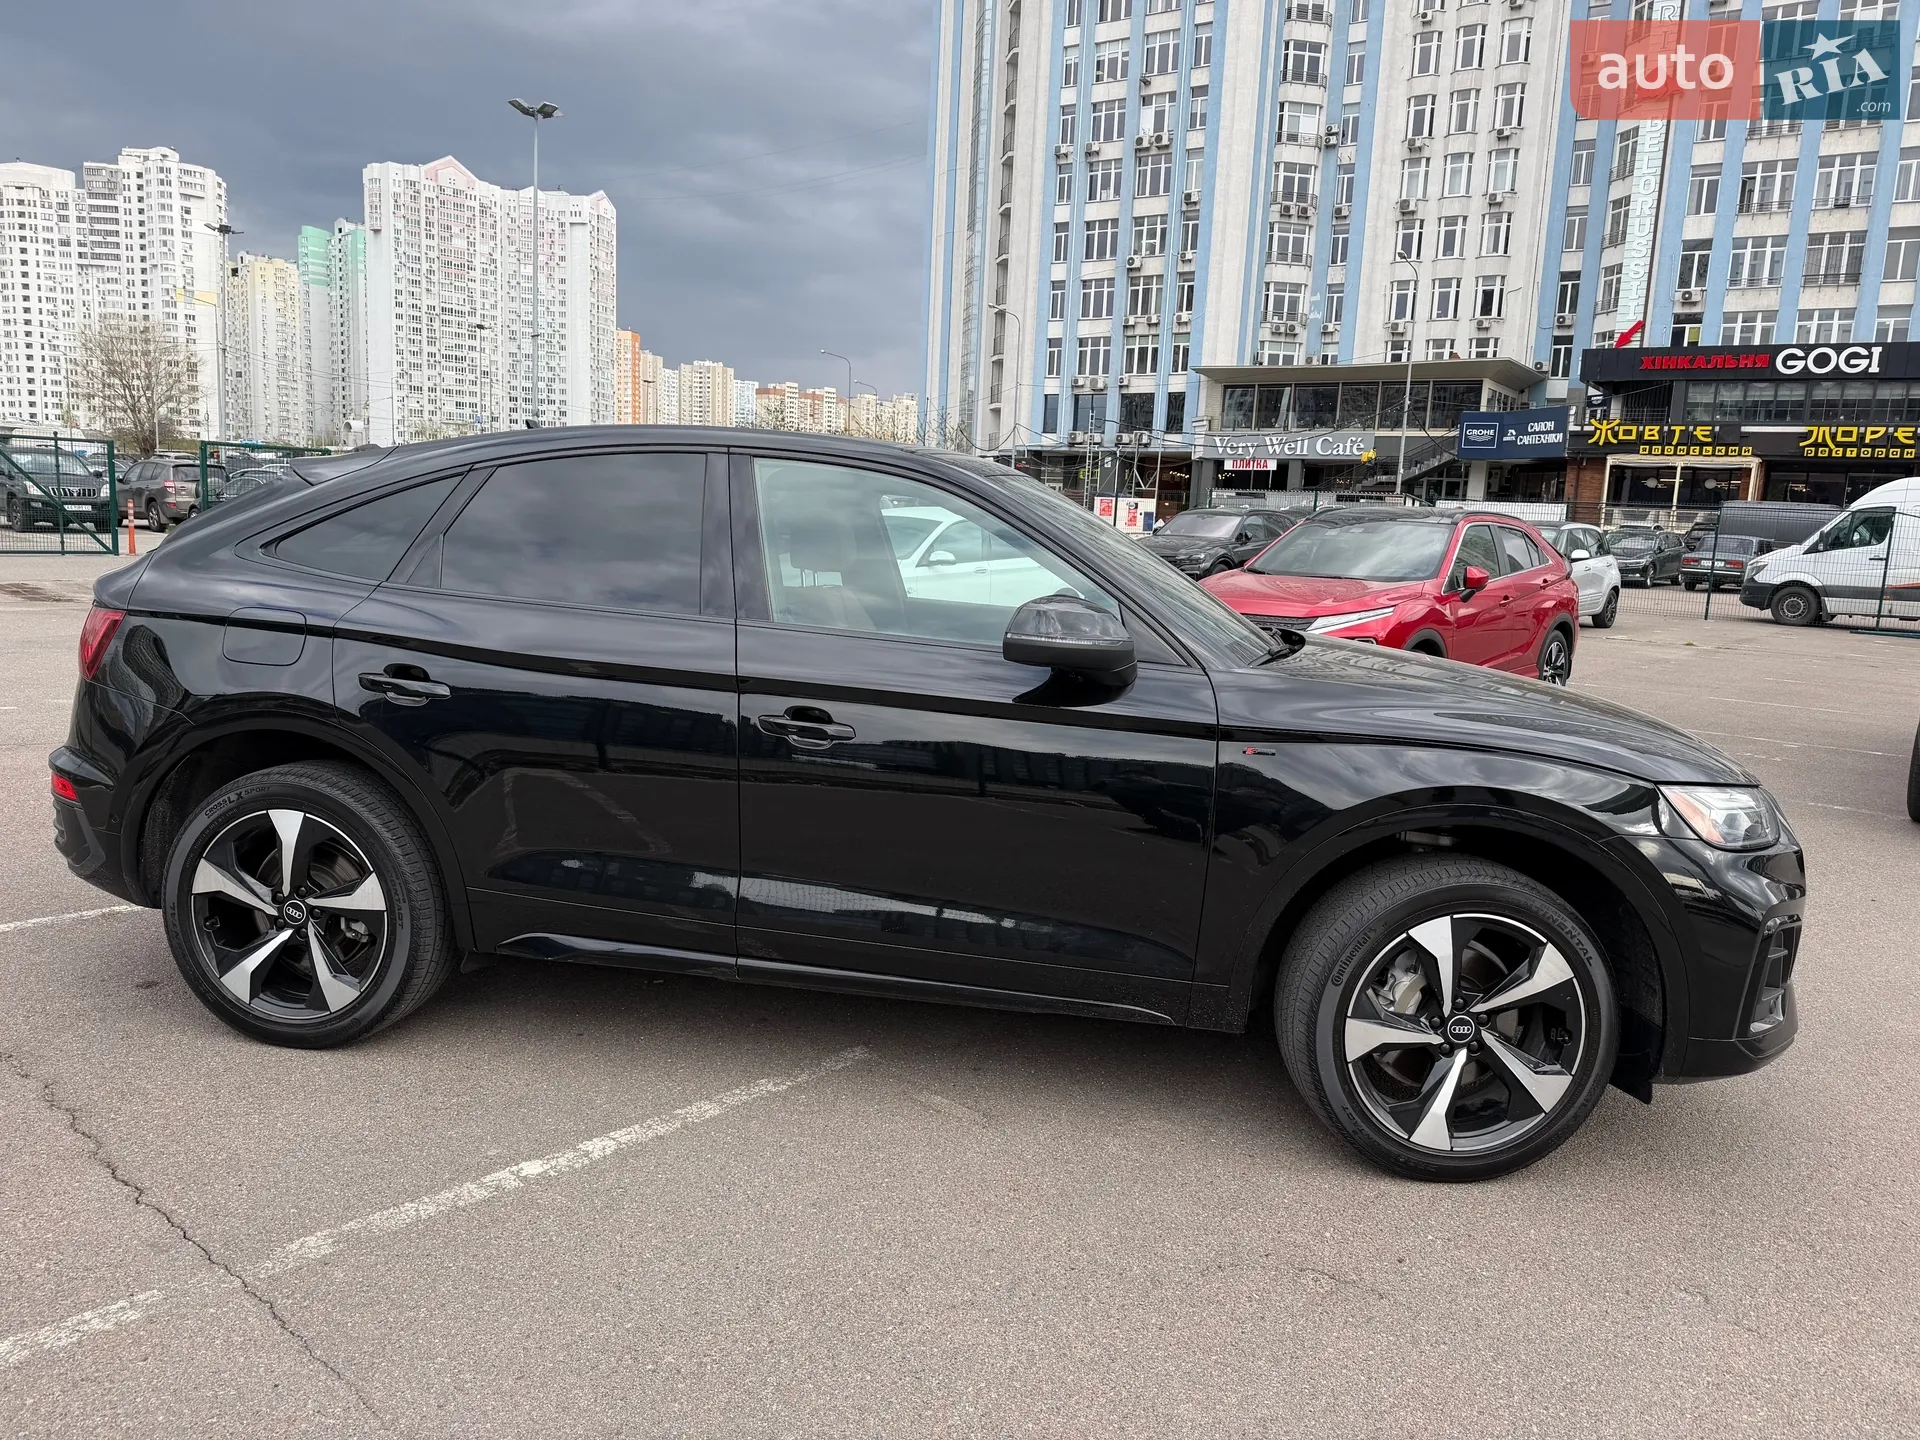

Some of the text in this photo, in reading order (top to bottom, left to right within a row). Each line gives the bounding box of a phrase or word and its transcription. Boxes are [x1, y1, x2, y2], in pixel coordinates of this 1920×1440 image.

[1640, 346, 1883, 375] ХІНКАЛЬНЯ GOGI
[1528, 421, 1555, 432] САЛОН
[1213, 436, 1365, 459] Very Well Café
[1517, 433, 1563, 445] САНТЕХНІКИ
[1231, 458, 1269, 470] ПЛИТКА
[1331, 932, 1372, 987] Continental
